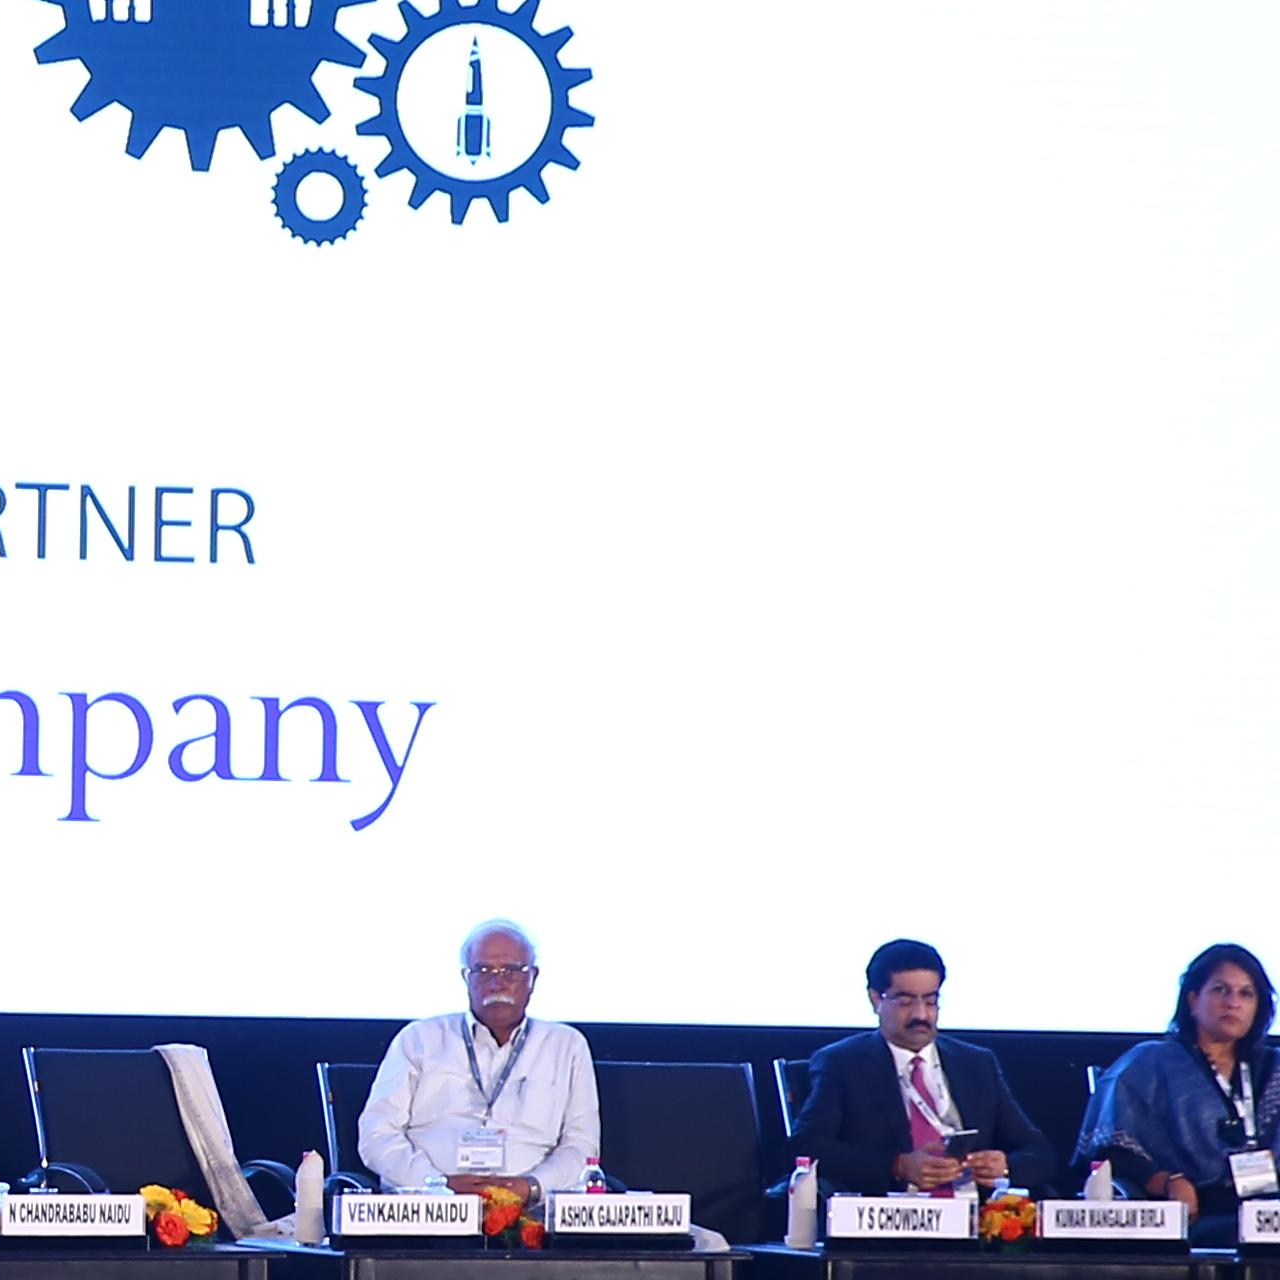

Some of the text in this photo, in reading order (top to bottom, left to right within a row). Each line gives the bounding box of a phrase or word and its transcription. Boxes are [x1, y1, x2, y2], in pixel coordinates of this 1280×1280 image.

[9, 1202, 132, 1224] N CHANDRABABU NAIDU
[347, 1202, 469, 1223] VENKAIAH NAIDU
[560, 1205, 683, 1228] ASHOK GAJAPATHI RAJU
[856, 1206, 943, 1232] Y S CHOWDARY
